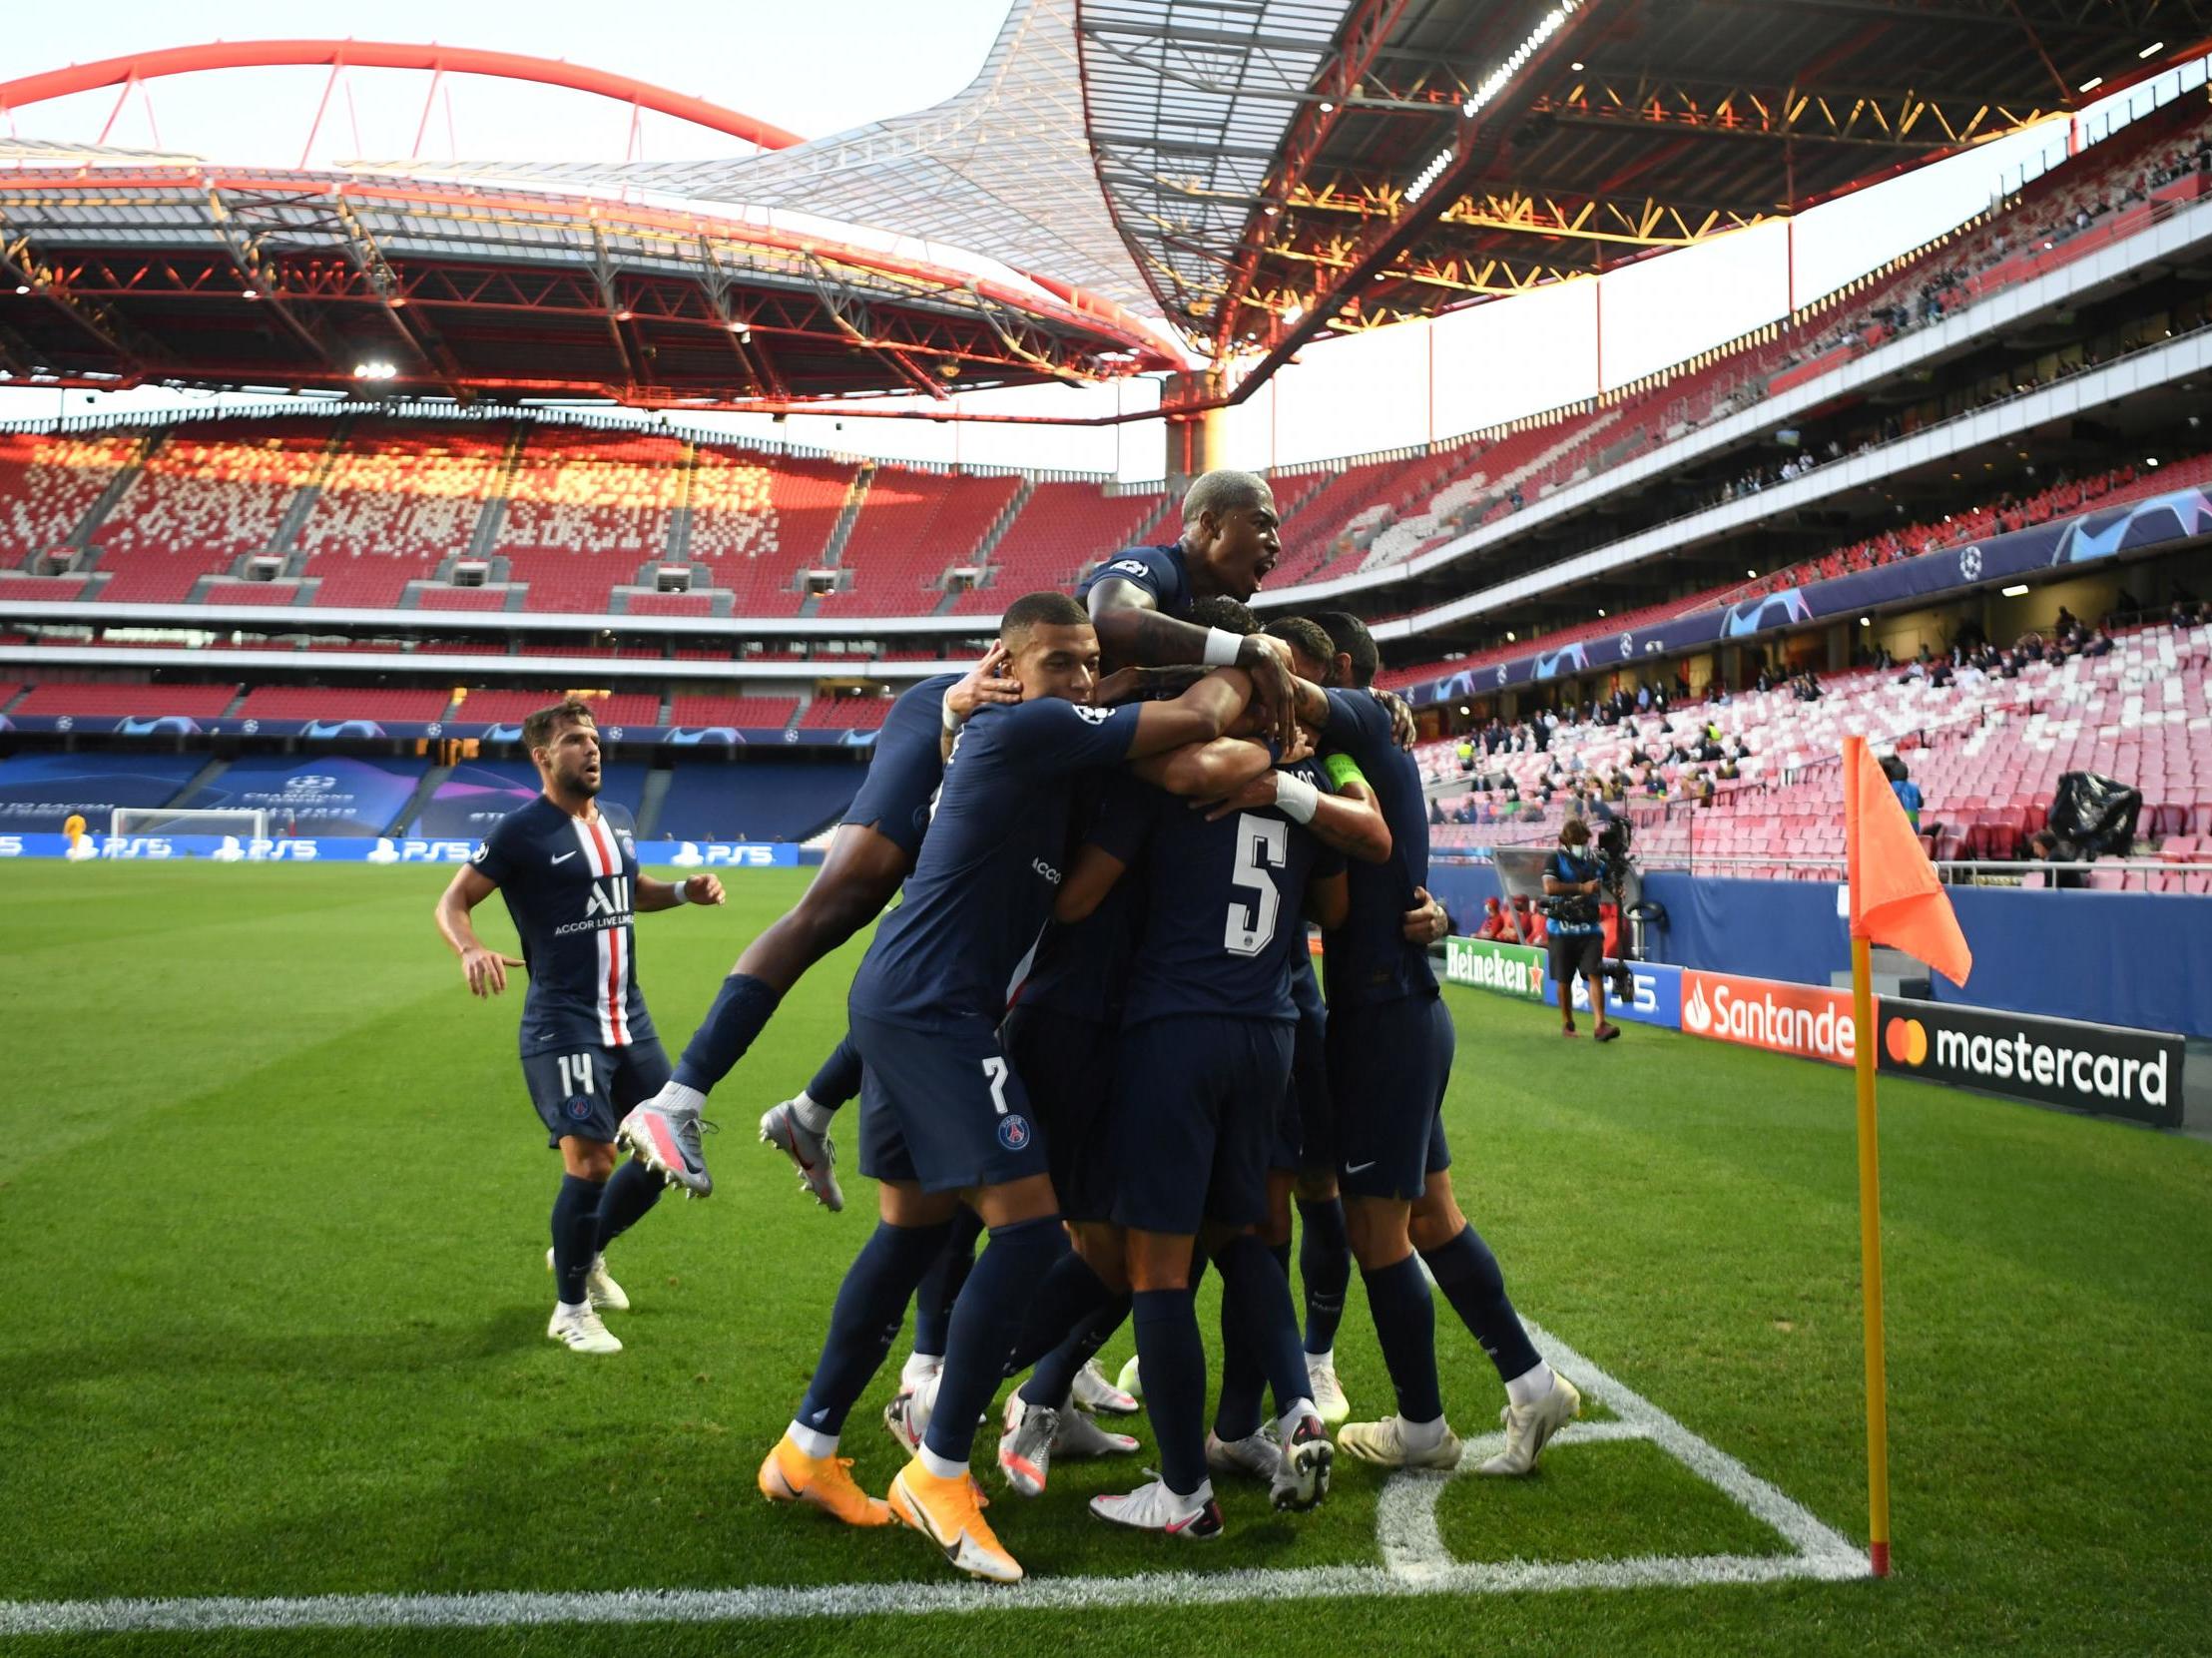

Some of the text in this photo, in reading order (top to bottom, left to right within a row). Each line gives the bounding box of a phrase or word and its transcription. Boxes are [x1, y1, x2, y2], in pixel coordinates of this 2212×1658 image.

[102, 837, 173, 859] PS5
[250, 839, 318, 861] PS5
[400, 841, 472, 861] PS5
[708, 845, 774, 863] PS5
[1031, 857, 1062, 885] ACCO
[1225, 813, 1288, 957] 5
[555, 919, 596, 936] ACCOR
[597, 915, 619, 928] LIVE
[1447, 941, 1527, 992] Heineken
[1714, 984, 1857, 1059] Santande
[558, 1052, 595, 1097] 14
[982, 1056, 1009, 1113] 7
[1936, 1028, 2167, 1107] mastercard
